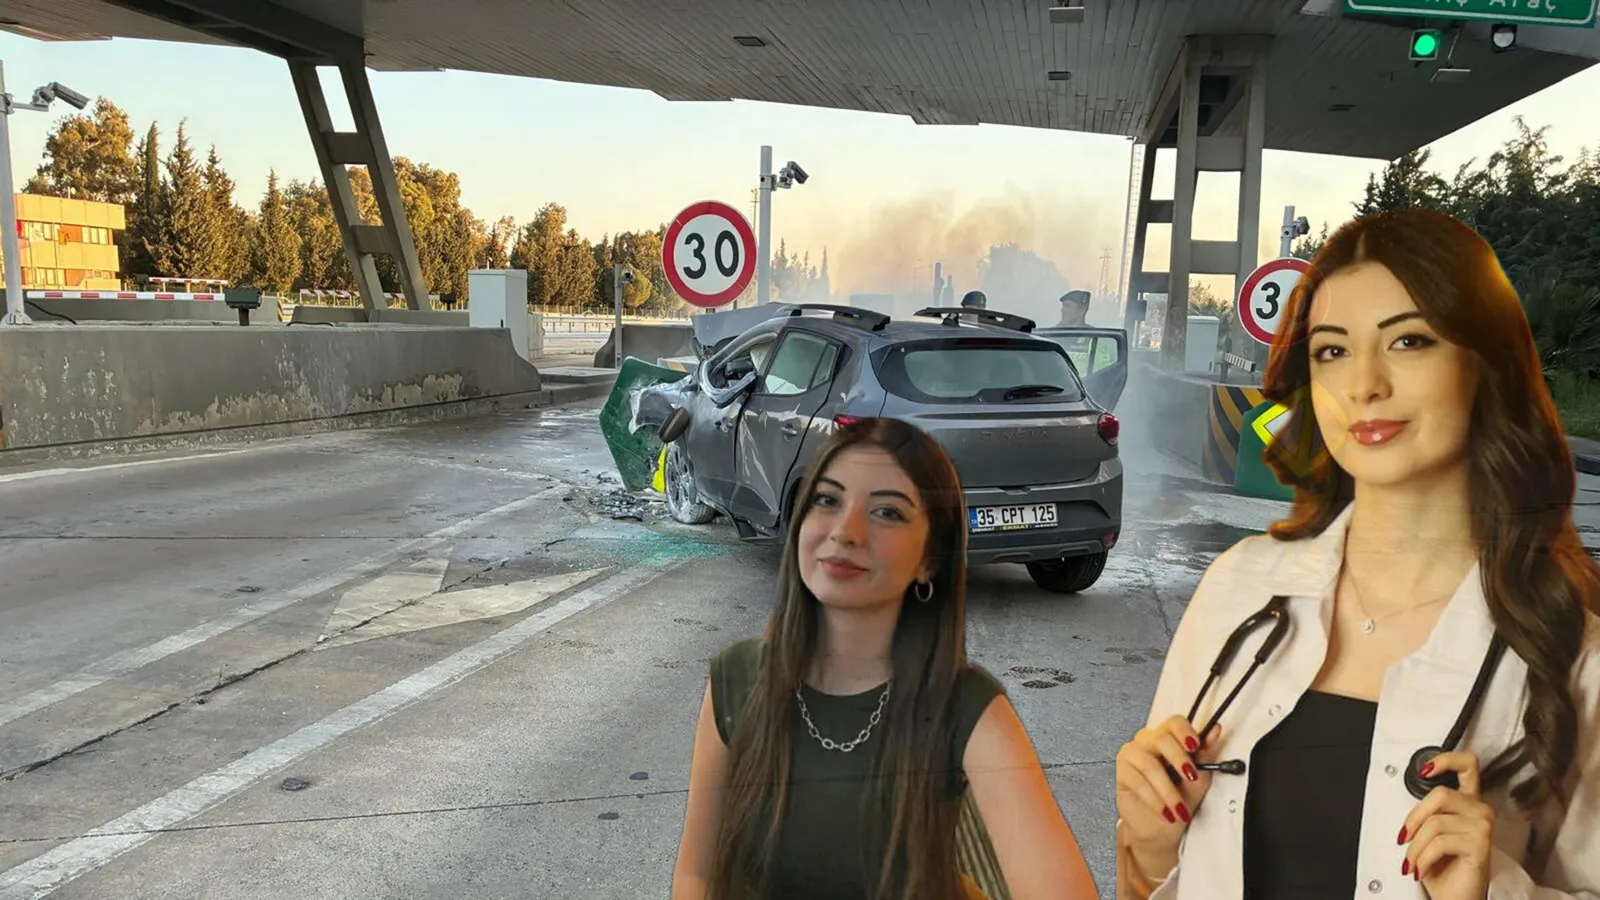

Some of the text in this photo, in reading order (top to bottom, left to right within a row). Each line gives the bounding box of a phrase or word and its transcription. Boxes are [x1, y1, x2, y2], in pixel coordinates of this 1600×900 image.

[683, 230, 739, 279] 30
[1256, 282, 1293, 319] 3
[978, 505, 1055, 525] 35 CPT 125
